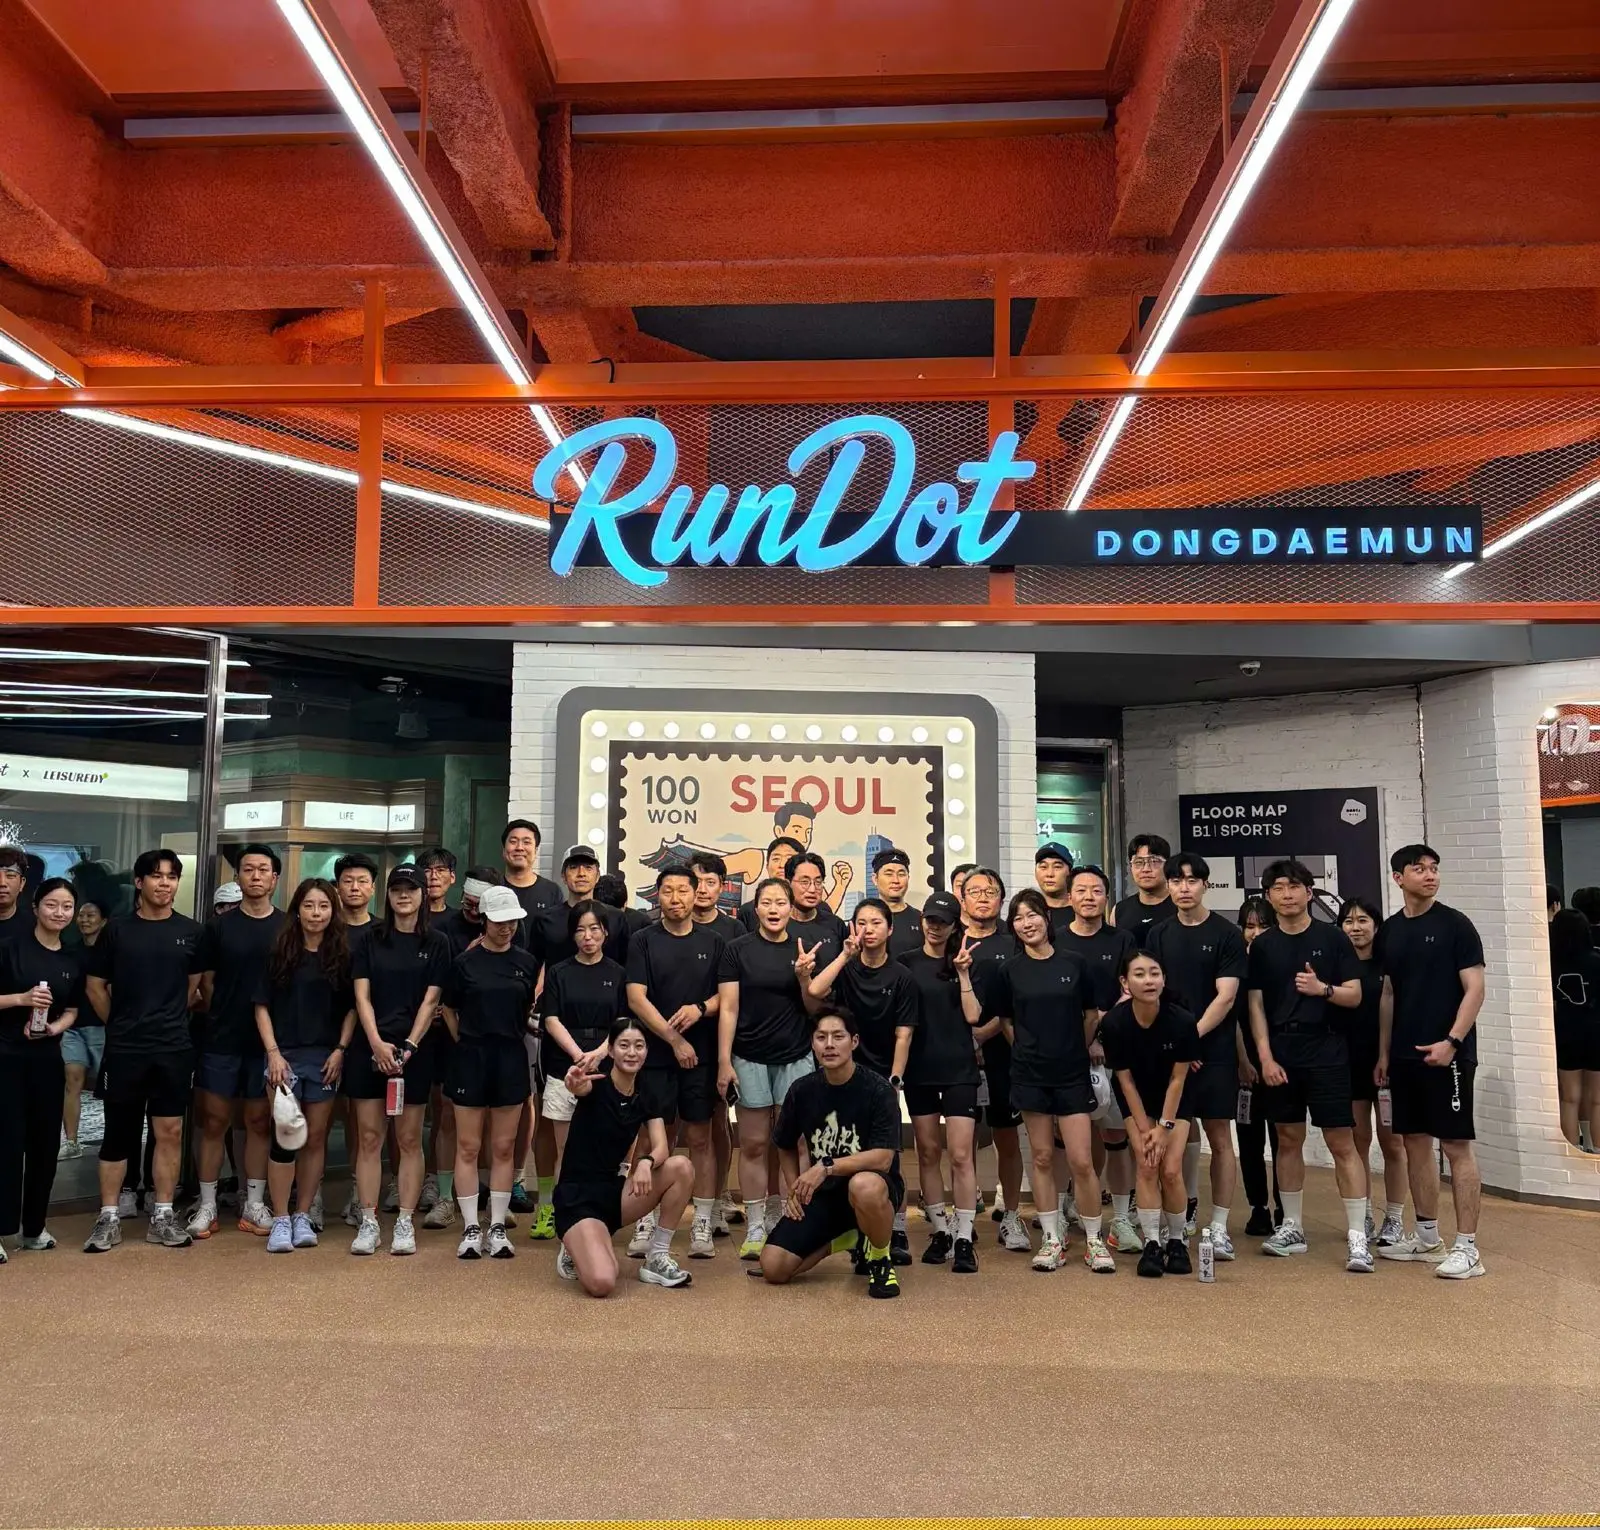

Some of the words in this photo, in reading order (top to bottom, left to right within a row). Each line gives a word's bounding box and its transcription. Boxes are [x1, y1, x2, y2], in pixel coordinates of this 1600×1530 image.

[532, 414, 1036, 588] RunDot
[1097, 527, 1473, 556] DONGDAEMUN
[43, 770, 105, 784] LEISUREDY
[641, 775, 700, 805] 100
[730, 775, 896, 815] SEOUL
[246, 811, 259, 819] RUN
[339, 811, 355, 820] LIFE
[394, 814, 410, 822] PLAY
[647, 809, 697, 824] WON
[1192, 806, 1246, 819] FLOOR
[1251, 804, 1287, 817] MAP
[1192, 825, 1211, 837] B1
[1220, 823, 1282, 836] SPORTS
